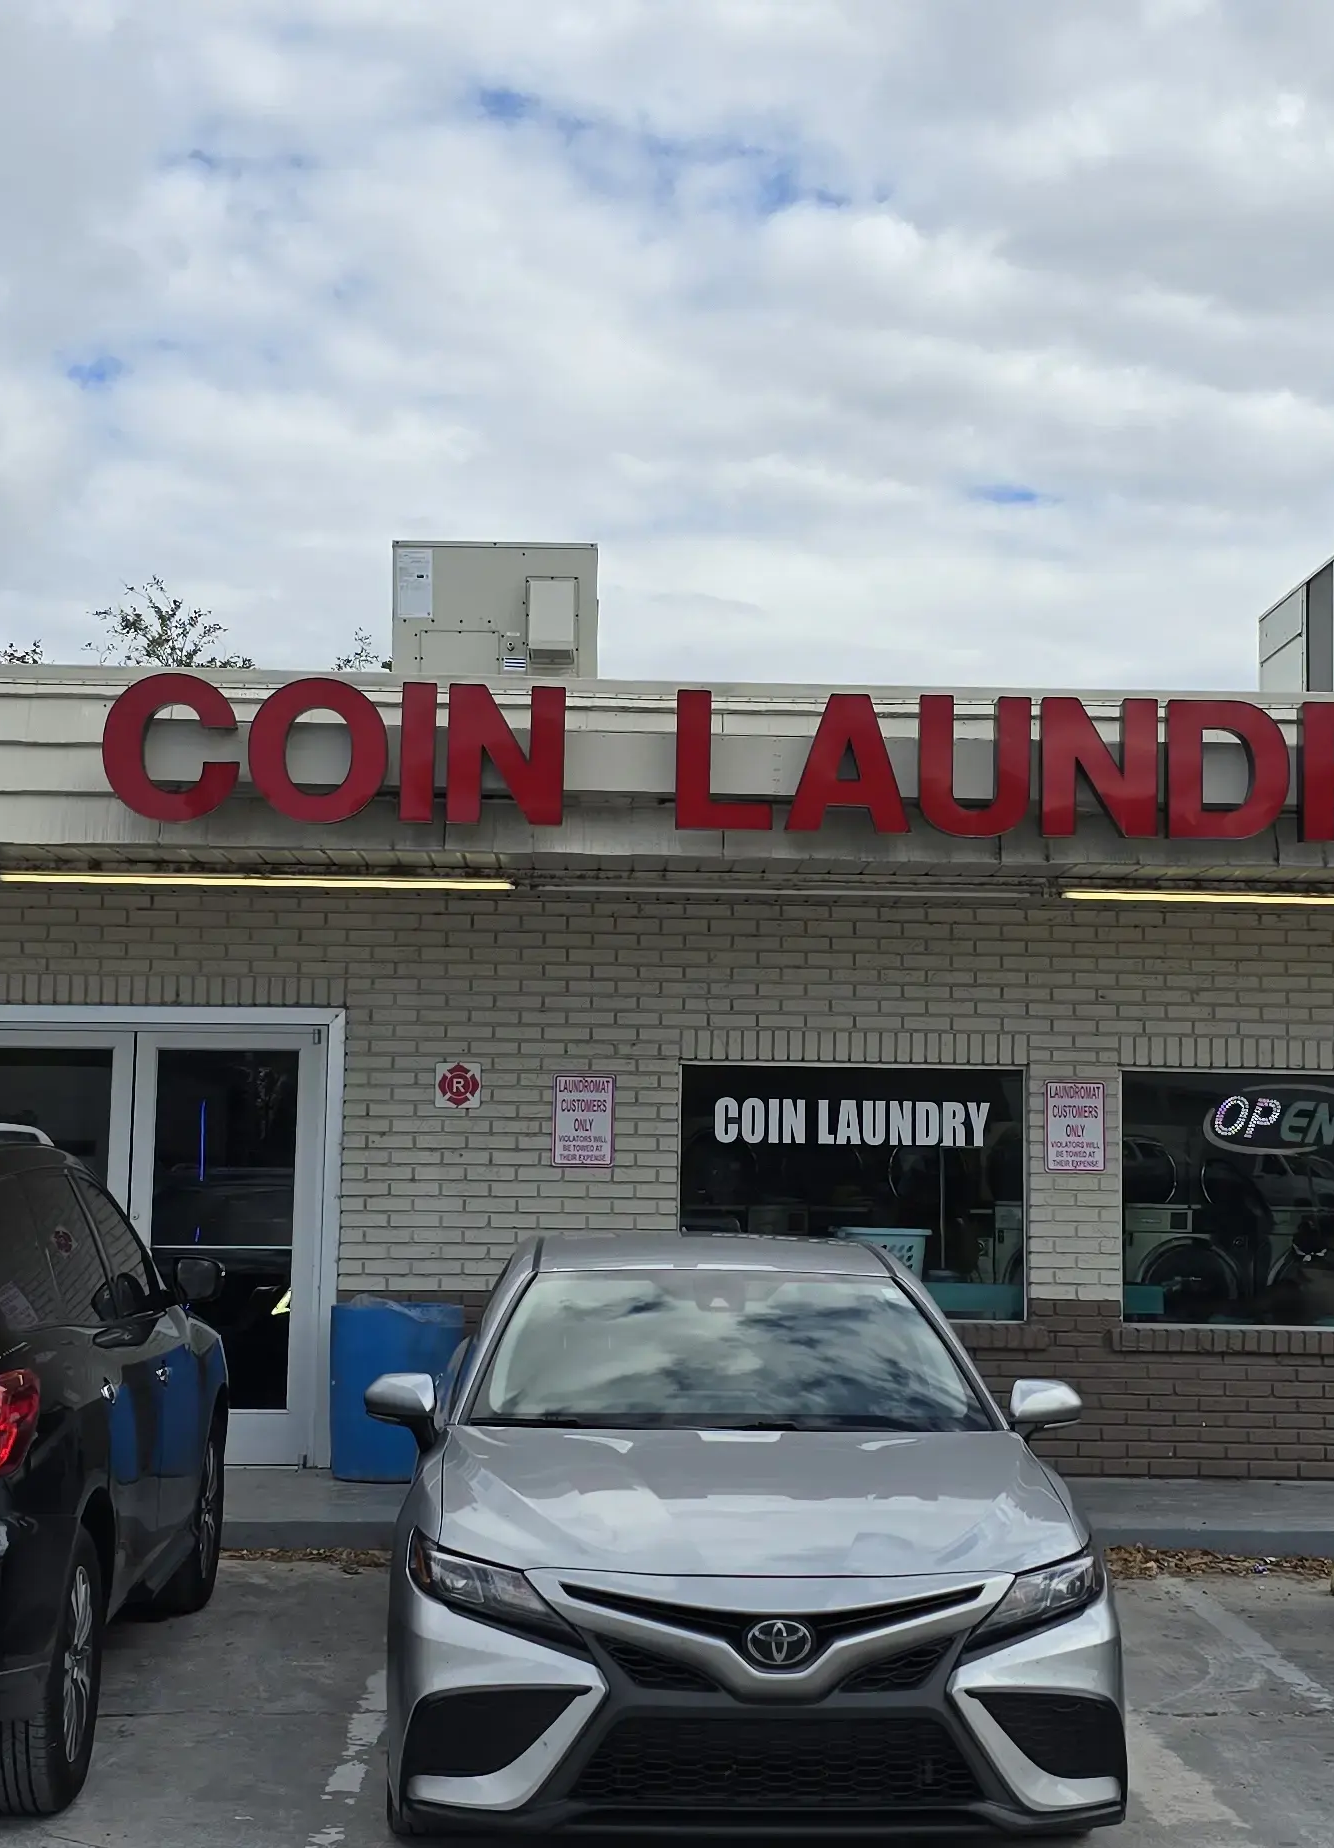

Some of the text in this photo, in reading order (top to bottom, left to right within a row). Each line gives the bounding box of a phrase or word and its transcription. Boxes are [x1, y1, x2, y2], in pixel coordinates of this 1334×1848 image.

[102, 672, 566, 826] COIN
[452, 1078, 465, 1093] R
[559, 1079, 610, 1094] LAUNDROMAT
[1049, 1085, 1101, 1100] LAUNDROMAT
[561, 1099, 607, 1113] CUSTOMERS
[1052, 1104, 1098, 1119] CUSTOMERS
[573, 1118, 594, 1132] ONLY
[714, 1096, 991, 1147] COIN LAUNDRY
[1065, 1124, 1086, 1138] ONLY
[559, 1135, 608, 1144] VIOLATORS WILL
[1050, 1140, 1101, 1150] VIOLATORS WILL
[563, 1144, 572, 1152] BE
[573, 1144, 594, 1152] TOWED
[1056, 1150, 1096, 1159] BE TOWED AT
[559, 1153, 606, 1162] THEIR EXPENSE
[1052, 1159, 1099, 1169] THEIR EXPENSE
